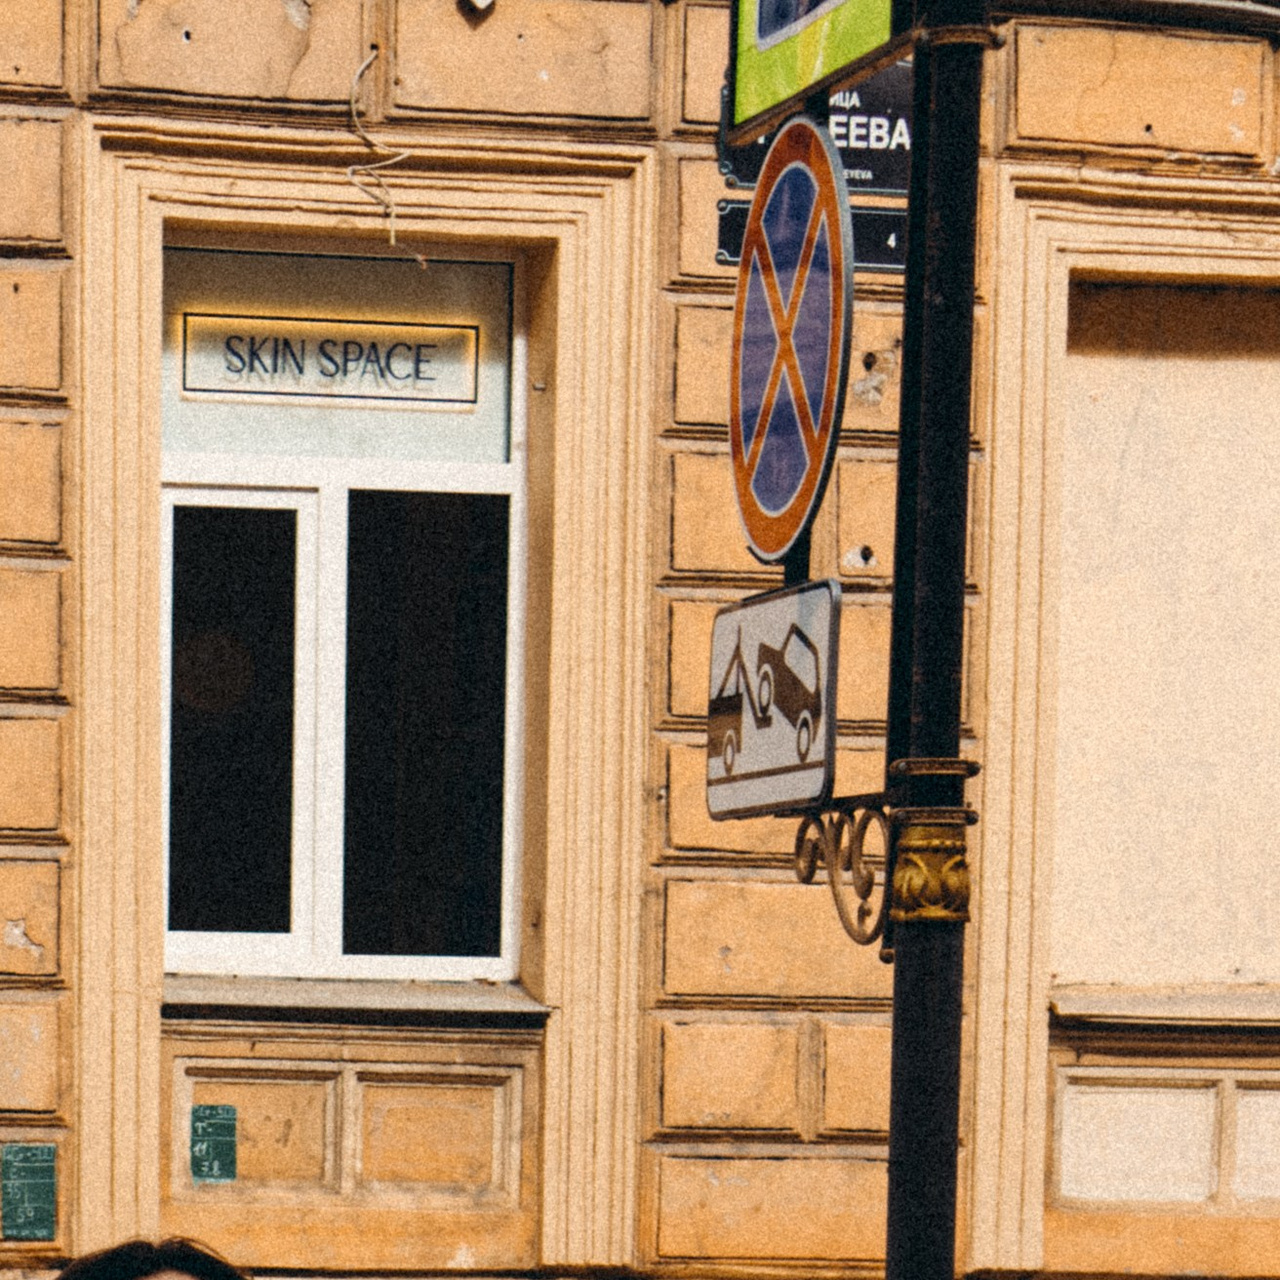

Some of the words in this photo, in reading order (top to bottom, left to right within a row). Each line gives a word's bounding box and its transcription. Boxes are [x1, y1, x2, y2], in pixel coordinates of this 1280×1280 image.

[828, 90, 861, 110] ИЦА
[828, 114, 911, 150] ЕЕВА
[842, 168, 874, 180] EYEVA
[886, 232, 896, 248] 4
[225, 334, 305, 375] SKIN
[320, 338, 438, 382] SPACE
